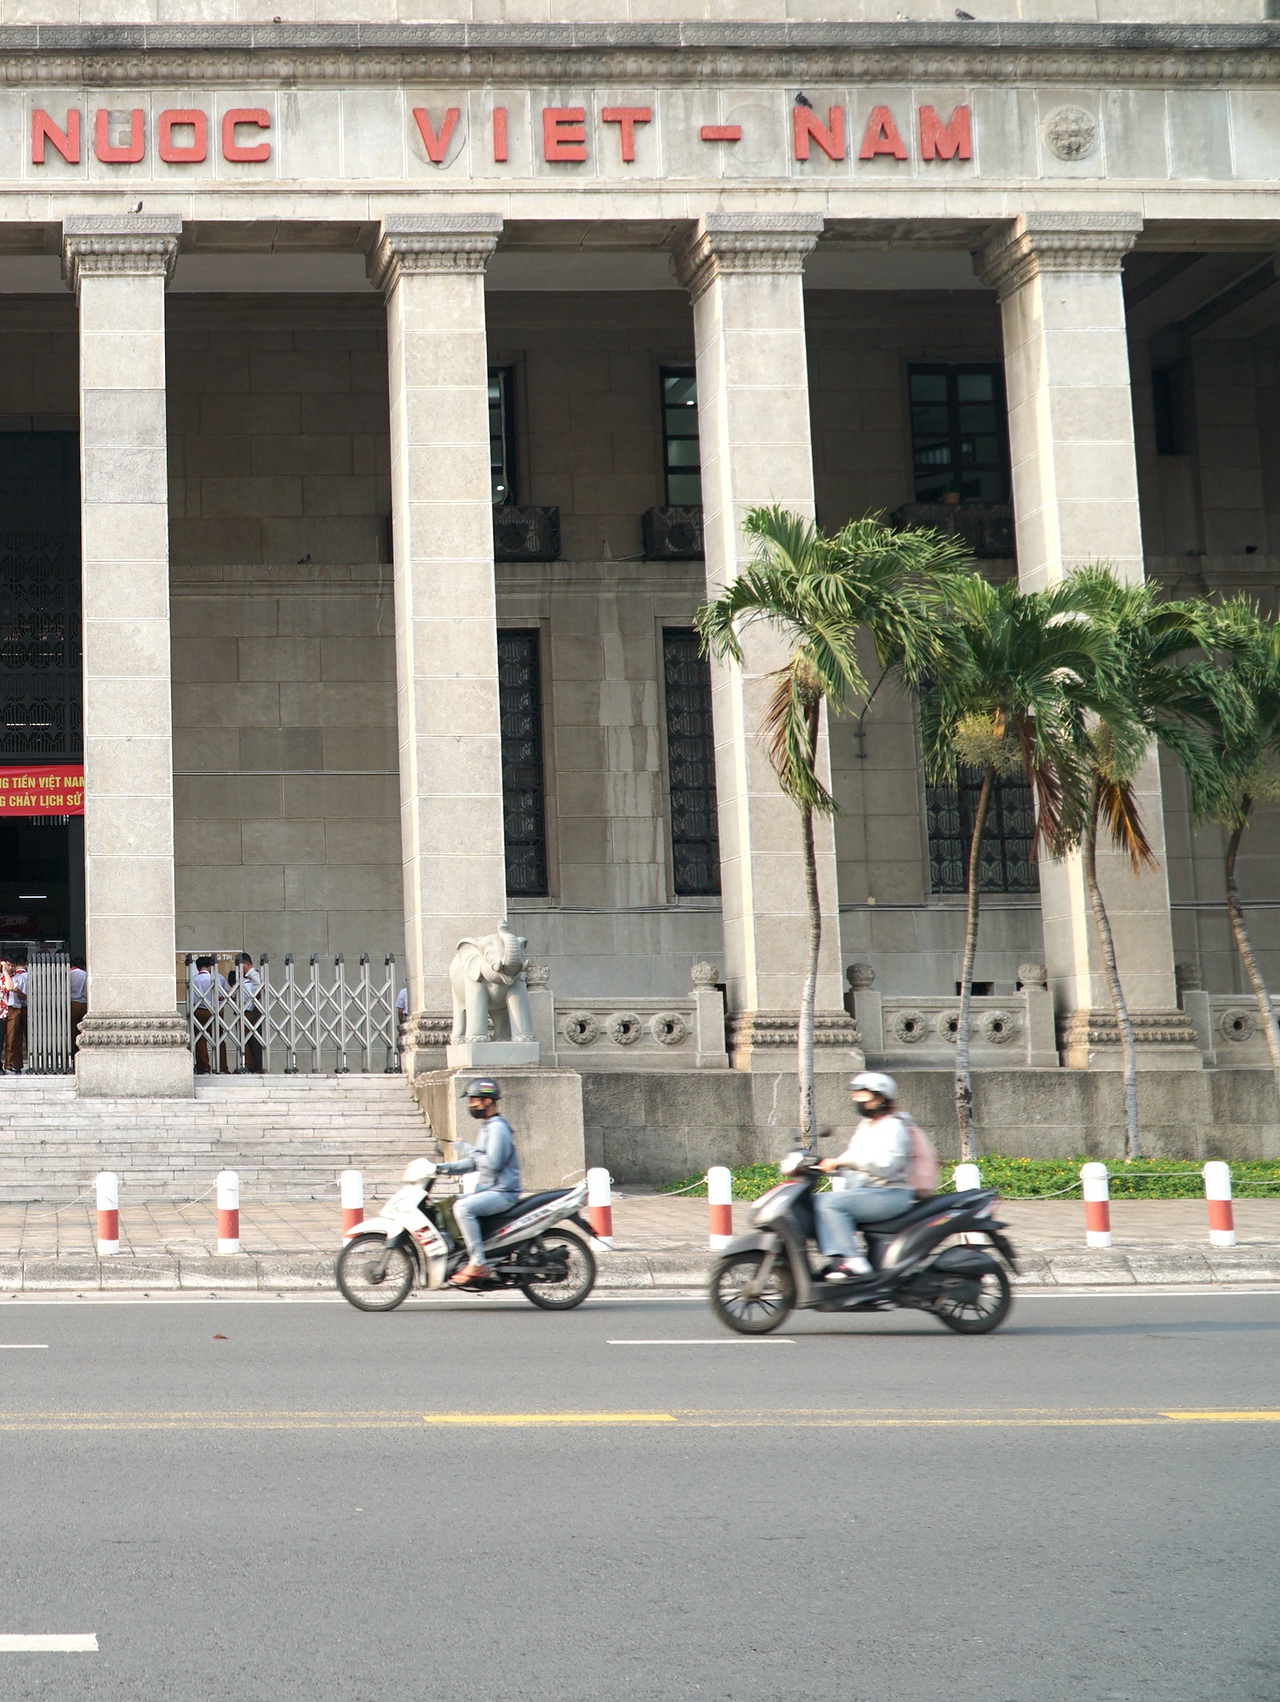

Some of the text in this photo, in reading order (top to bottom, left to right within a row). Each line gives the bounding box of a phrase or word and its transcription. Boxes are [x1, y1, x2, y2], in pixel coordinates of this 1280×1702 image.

[31, 108, 271, 164] NUOC
[412, 106, 651, 163] VIET
[792, 105, 971, 161] NAM
[39, 774, 61, 790] VIỆT
[9, 791, 37, 807] CHẢY
[40, 795, 64, 809] LỊCH
[66, 791, 82, 806] SỬ
